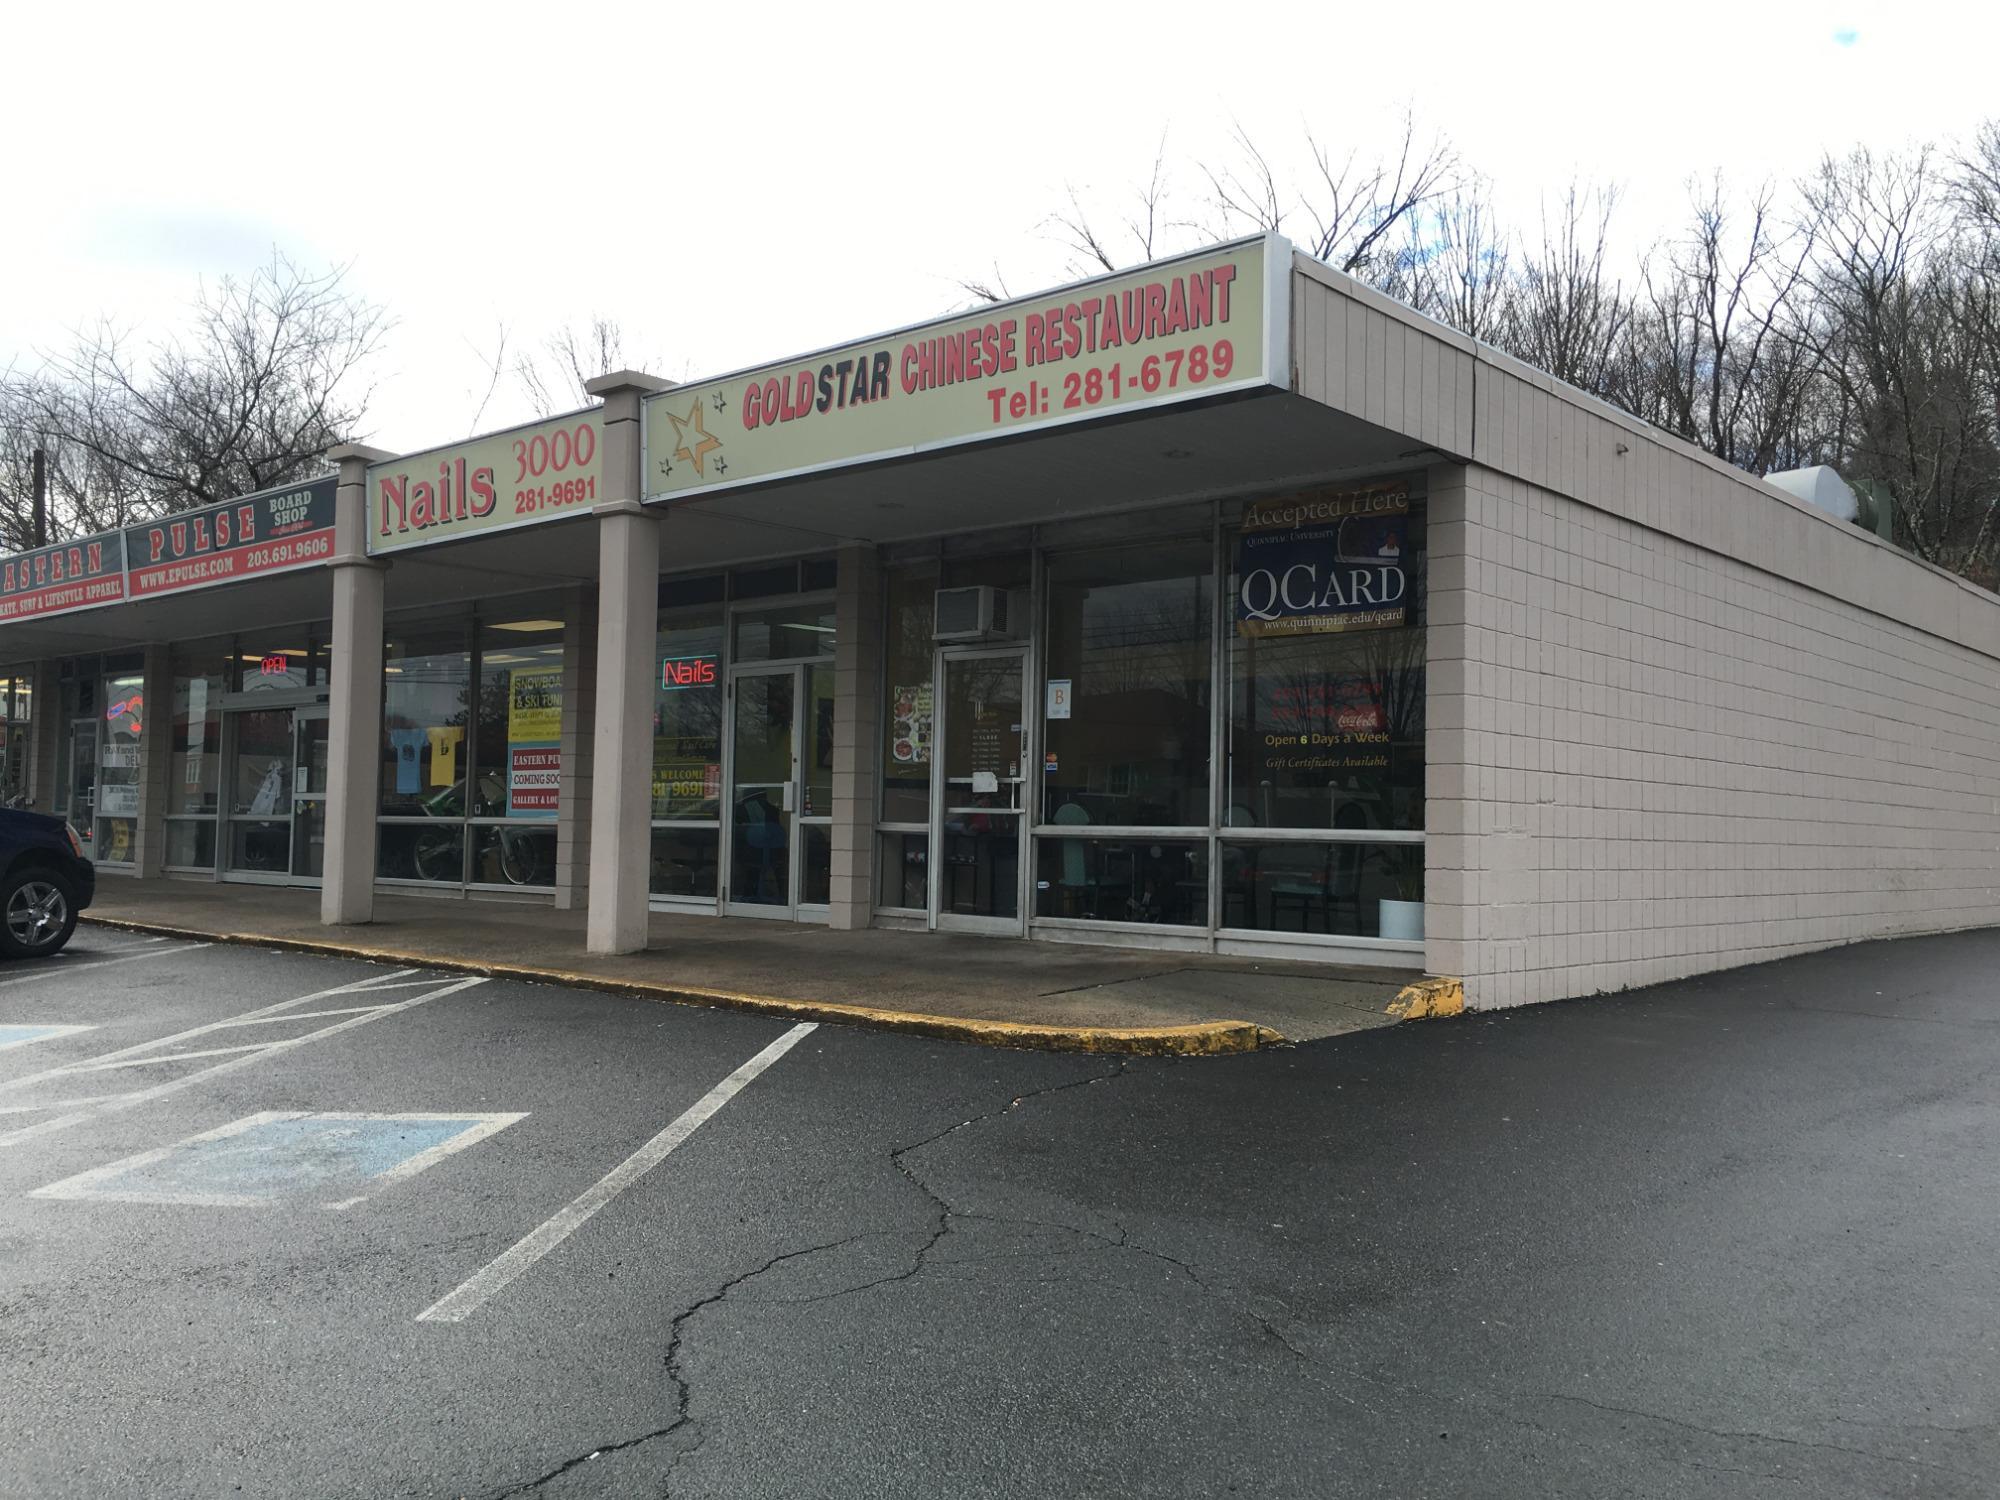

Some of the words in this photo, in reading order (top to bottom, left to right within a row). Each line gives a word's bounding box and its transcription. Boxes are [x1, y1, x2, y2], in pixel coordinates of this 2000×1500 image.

[741, 350, 893, 430] GOLDSTAR
[900, 318, 1018, 395] CHINESE
[1025, 264, 1237, 367] RESTAURANT
[988, 385, 1049, 423] Tel:
[1063, 338, 1234, 410] 281-6789
[379, 456, 496, 536] Nails
[512, 423, 595, 484] 3000
[269, 491, 312, 513] BOARD
[515, 475, 596, 514] 281-9691
[274, 506, 308, 527] SHOP
[1244, 493, 1343, 529] Accepted
[1348, 488, 1407, 514] Here
[150, 504, 255, 561] PULSE
[140, 556, 233, 589] WWW.EPULSE.COM
[247, 536, 328, 568] 203.691.9606
[45, 587, 84, 607] LIFESTYLE
[86, 579, 122, 599] APPAREL
[1264, 607, 1403, 631] www.quinnipiac.edu/qcard
[261, 656, 287, 675] OPEN
[665, 659, 716, 684] Nails
[516, 695, 523, 708] &
[525, 694, 539, 707] SKI
[1055, 688, 1064, 705] B
[1265, 734, 1297, 747] Open
[1300, 735, 1308, 745] 6
[1311, 733, 1340, 748] Days
[1343, 735, 1351, 743] a
[1353, 732, 1389, 743] Week
[514, 754, 547, 766] EASTERN
[1266, 758, 1286, 770] Gift
[1288, 756, 1340, 770] Certificates
[1343, 755, 1389, 767] Available
[514, 774, 545, 785] COMING
[672, 781, 704, 796] 9691
[512, 795, 539, 804] GALLERY
